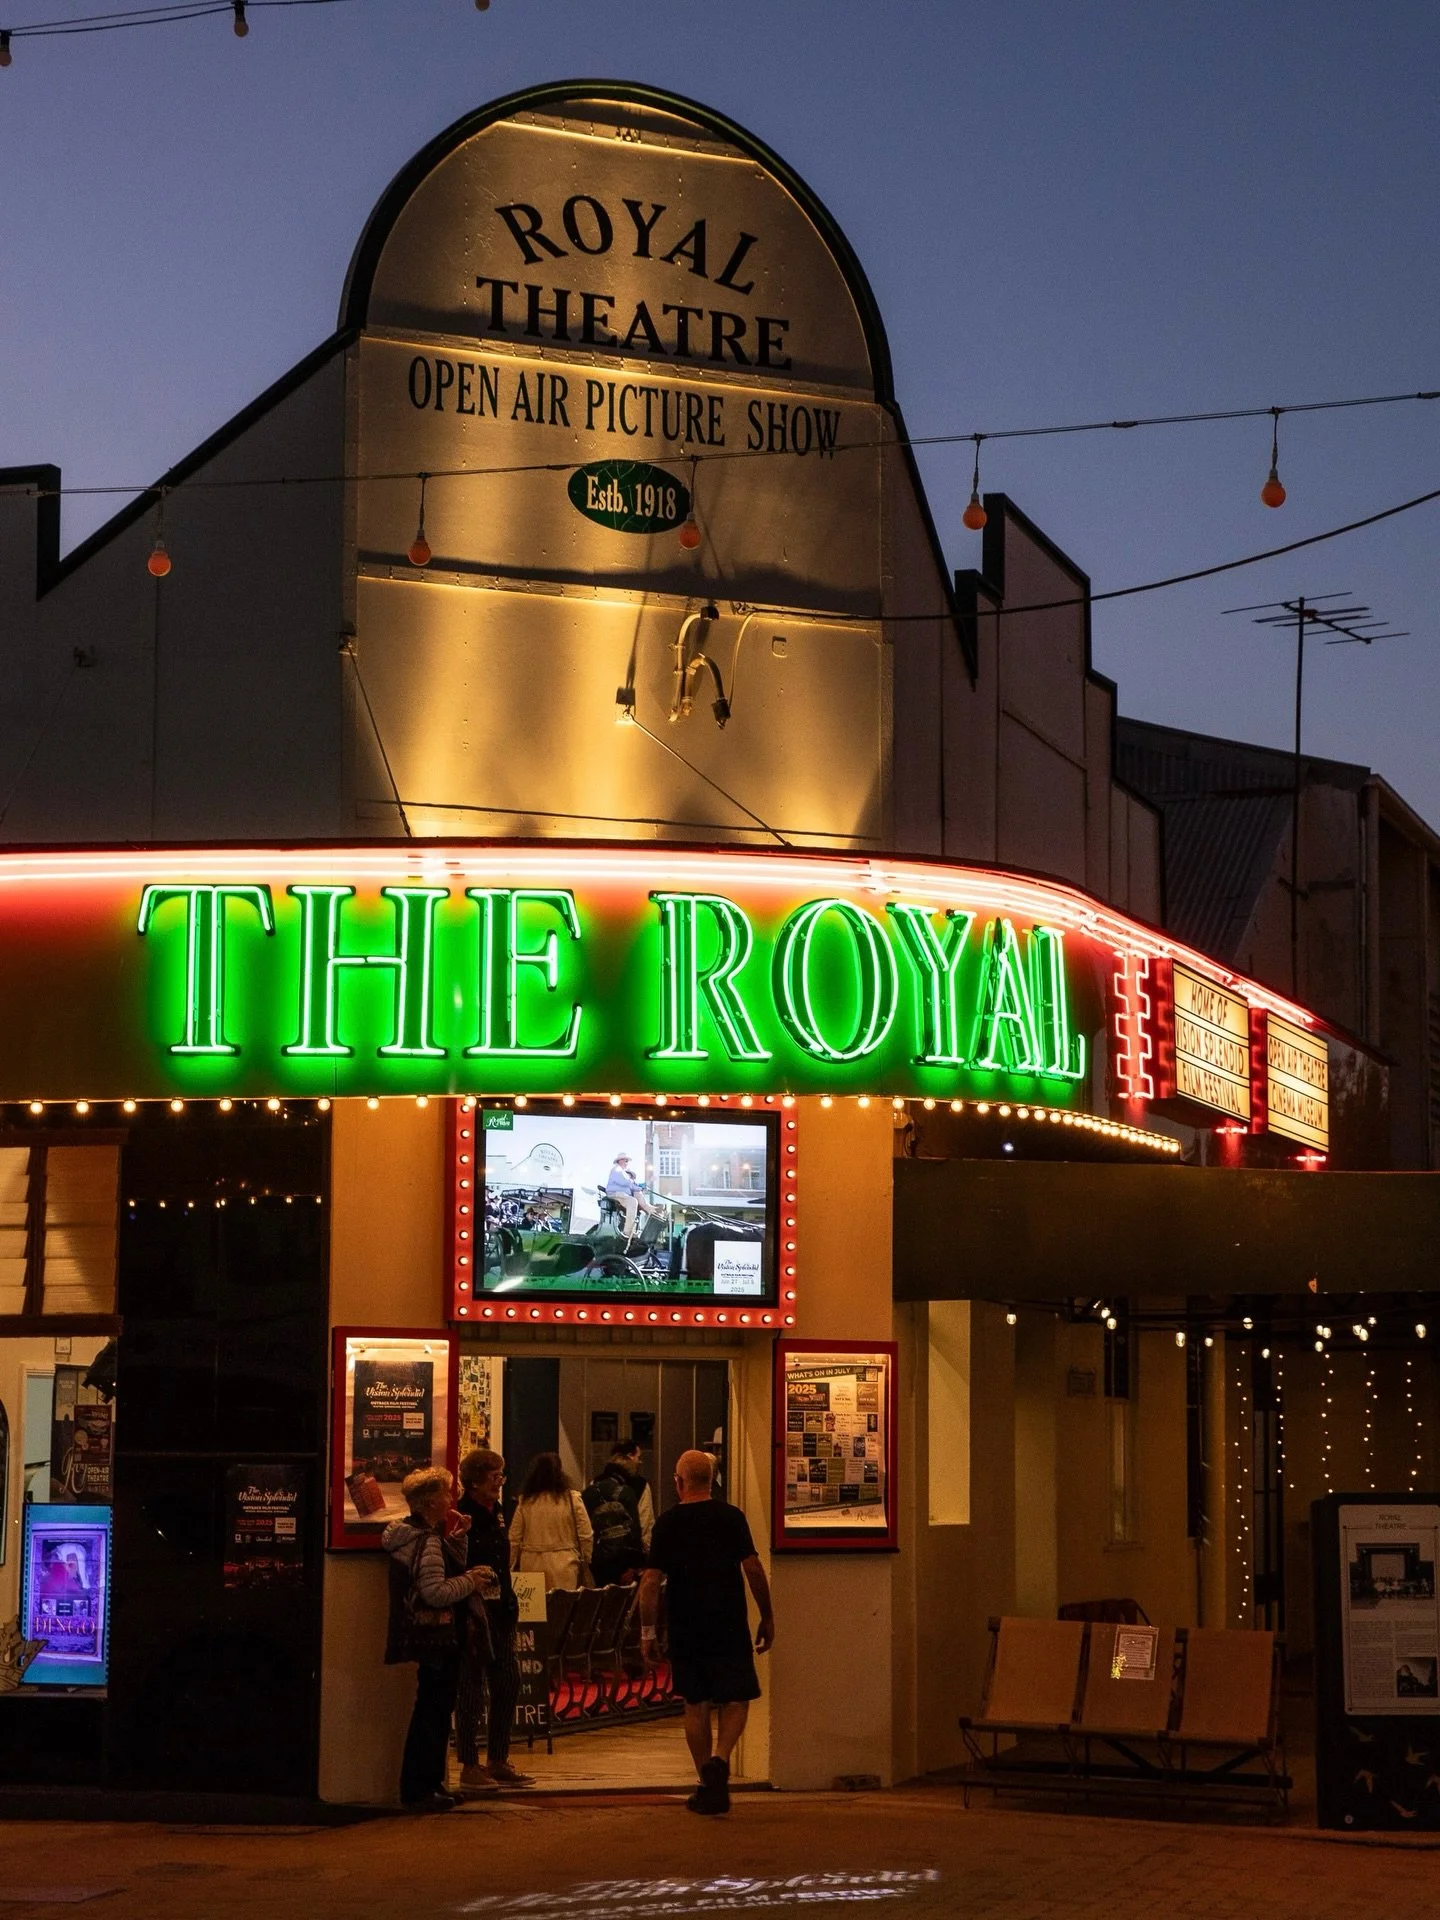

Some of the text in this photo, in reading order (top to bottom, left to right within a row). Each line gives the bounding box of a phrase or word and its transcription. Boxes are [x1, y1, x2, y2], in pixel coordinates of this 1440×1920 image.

[495, 195, 758, 296] ROYAL
[476, 276, 793, 371] THEATRE
[408, 355, 841, 459] OPEN AIR PICTURE SHOW
[586, 476, 677, 520] Estb. 1918
[137, 884, 1087, 1082] THE ROYAL
[1191, 982, 1228, 1026] HOME OF
[1176, 1017, 1244, 1075] VISION SPLENDID
[1268, 1037, 1325, 1089] OPEN AIR THEATRE
[1182, 1062, 1241, 1113] FILM FESTIVAL
[1272, 1083, 1323, 1129] CINEMA MUSEUM
[366, 1385, 425, 1400] Vision Splendid
[375, 1381, 388, 1390] The
[787, 1371, 814, 1380] WHAT'S
[834, 1367, 851, 1375] JULY
[788, 1383, 817, 1395] 2025
